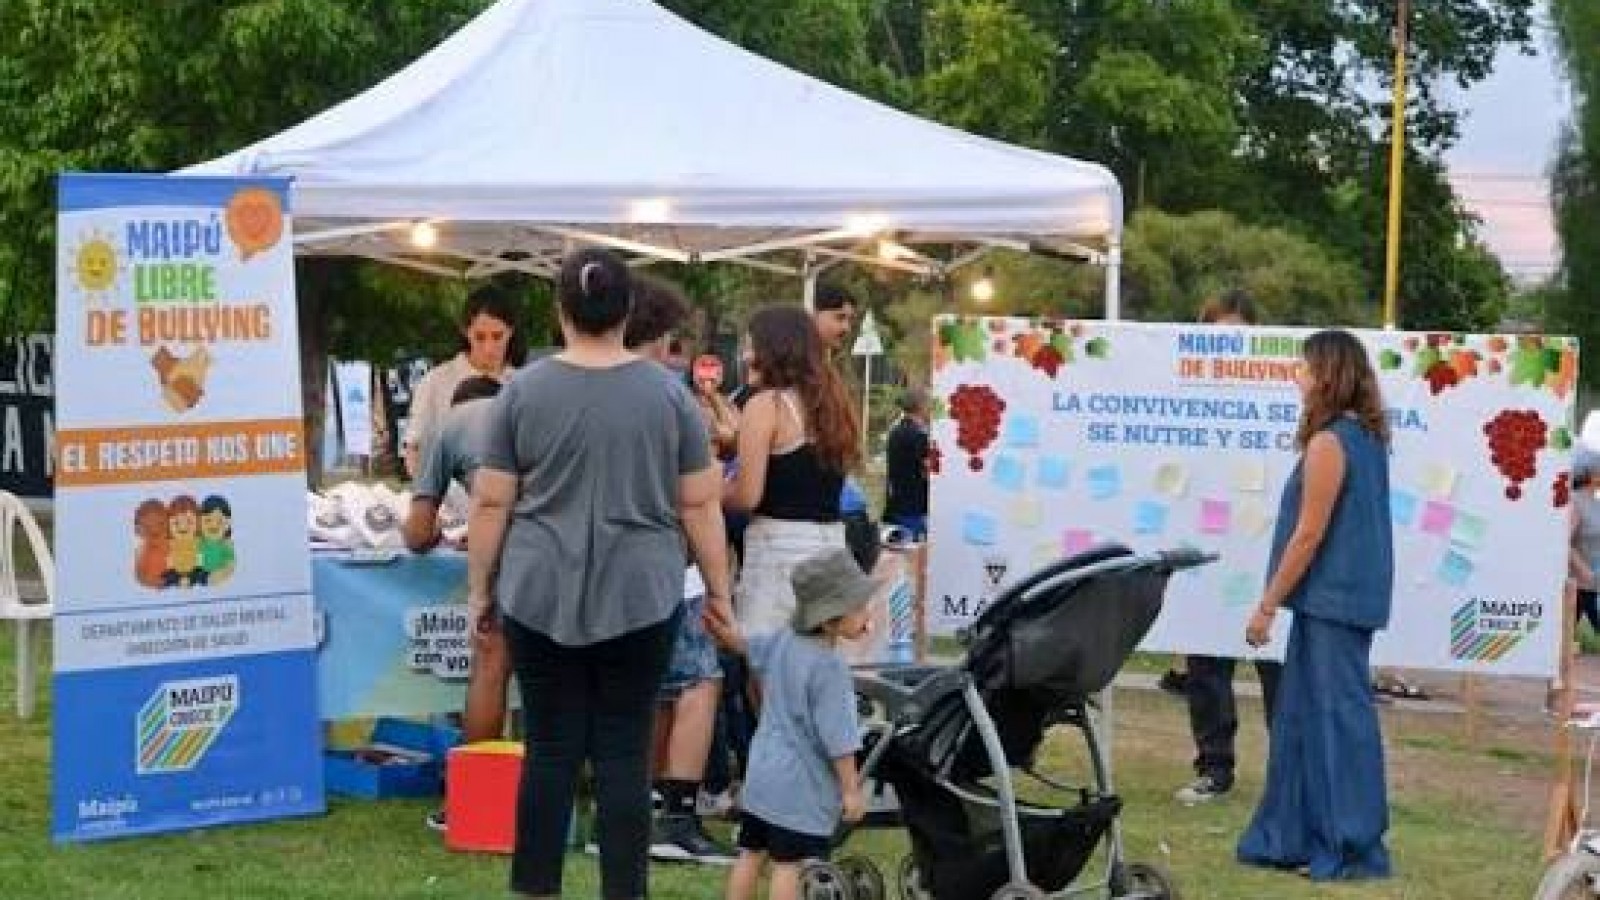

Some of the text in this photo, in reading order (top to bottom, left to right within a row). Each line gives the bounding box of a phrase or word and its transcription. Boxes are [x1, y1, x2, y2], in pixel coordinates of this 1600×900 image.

[126, 211, 221, 259] MAIPÚ
[136, 264, 215, 302] LIBRE
[86, 304, 269, 346] DE BULLYING
[1181, 359, 1205, 378] DE
[1052, 392, 1297, 423] LA CONVIVENCIA SE
[63, 431, 297, 473] EL RESPETO NOS UNE
[1088, 422, 1118, 442] SE
[1123, 425, 1208, 447] NUTRE
[1216, 431, 1232, 448] Y
[1239, 431, 1269, 449] SE
[170, 677, 232, 707] MAIPÚ
